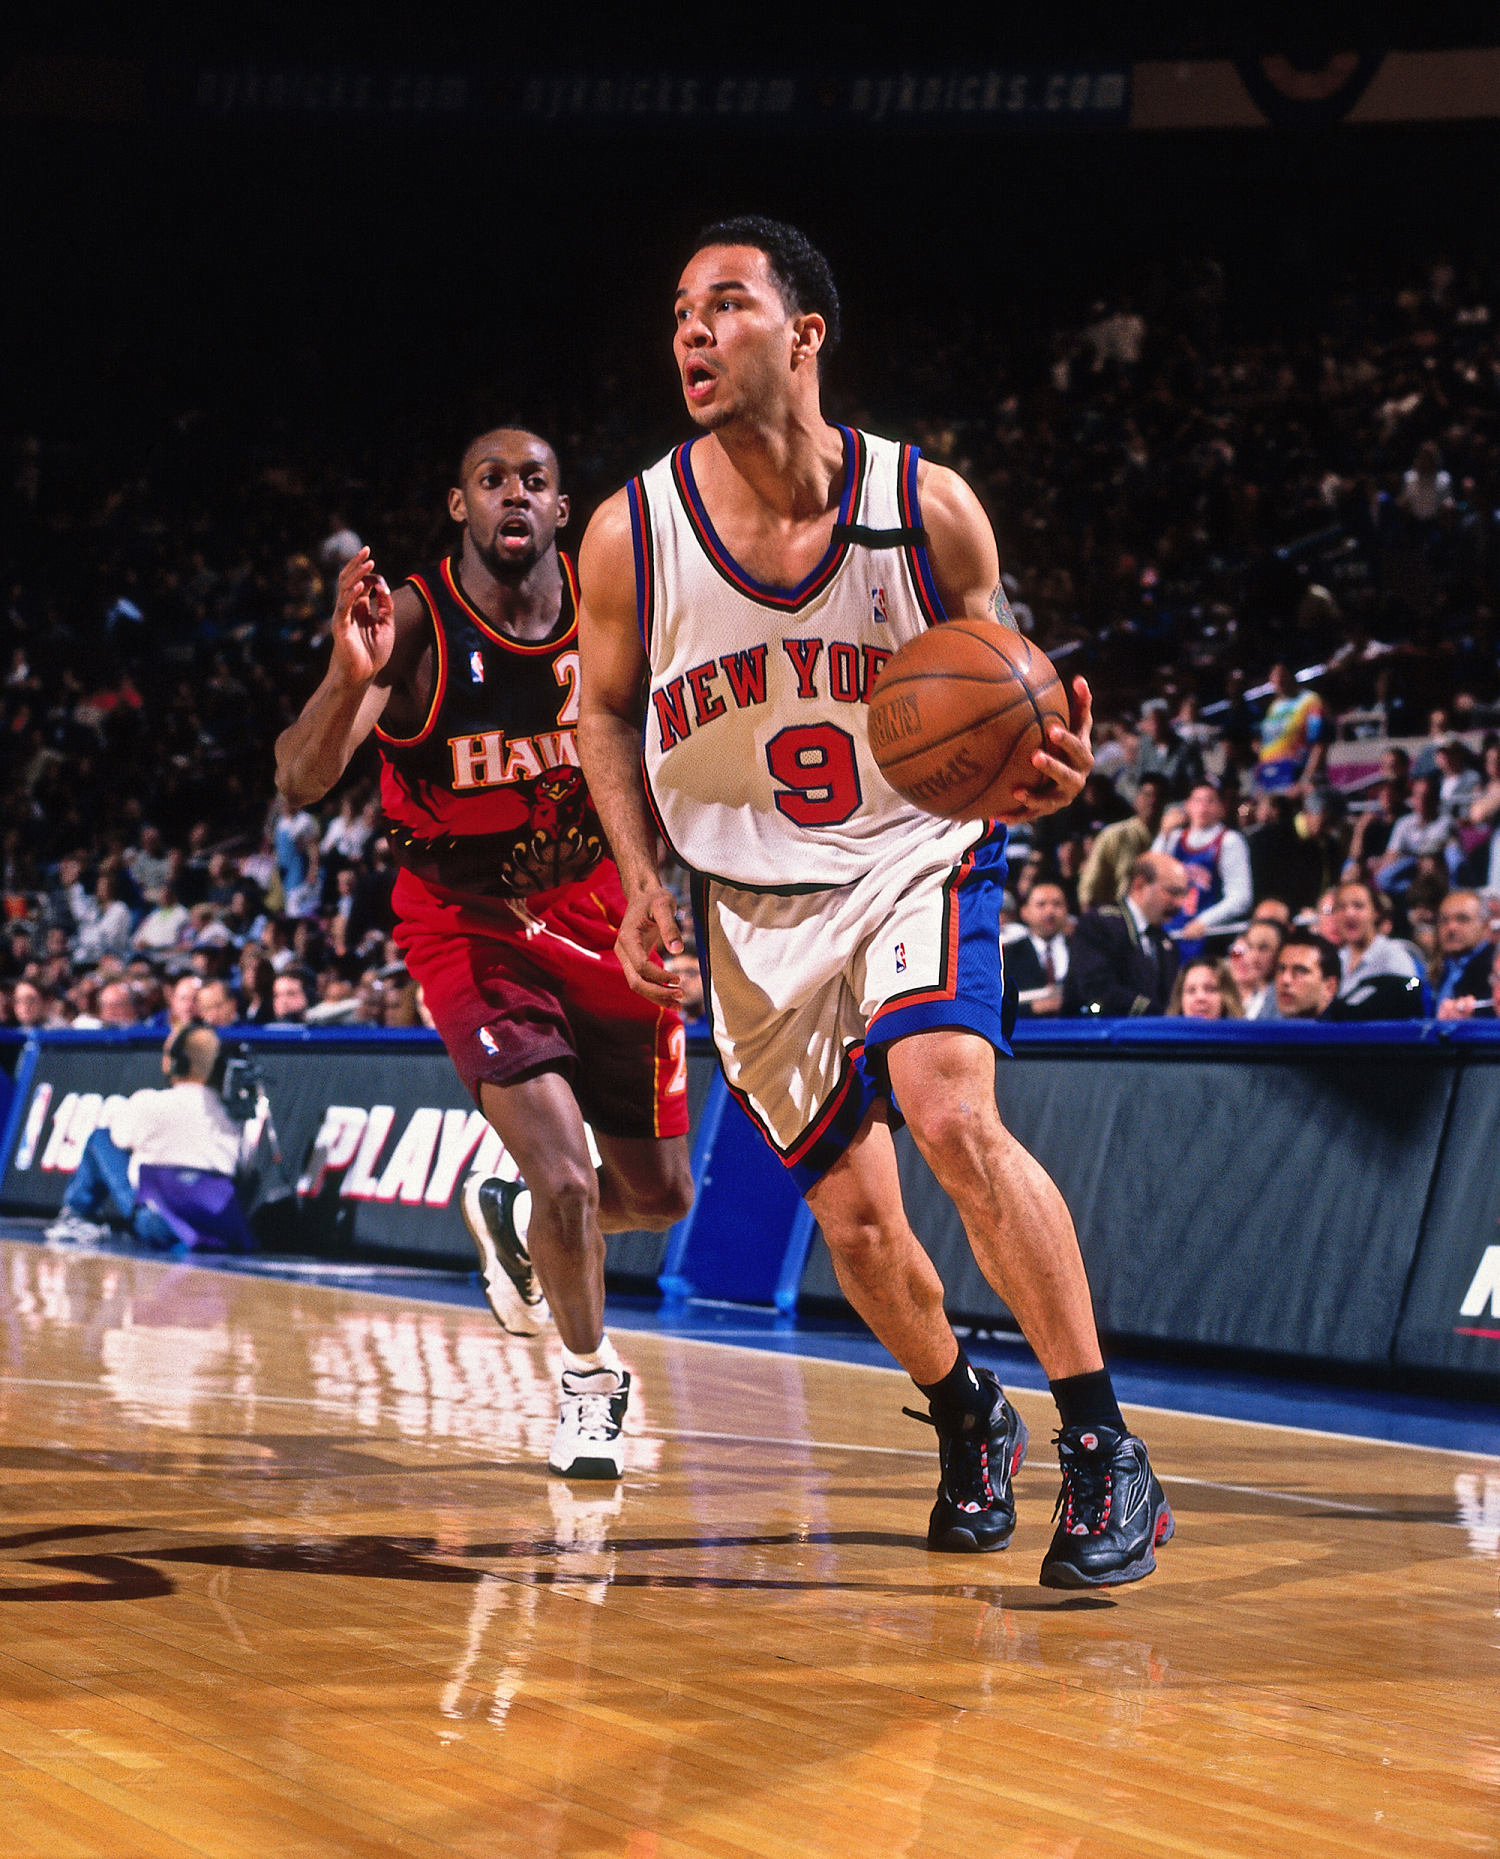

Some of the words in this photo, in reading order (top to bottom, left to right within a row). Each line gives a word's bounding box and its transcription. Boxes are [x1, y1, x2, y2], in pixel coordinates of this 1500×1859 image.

[850, 70, 1125, 120] nyknicks.com
[651, 641, 768, 754] NEW
[782, 638, 894, 705] YOR
[447, 729, 580, 790] HAW
[766, 721, 863, 828] 9
